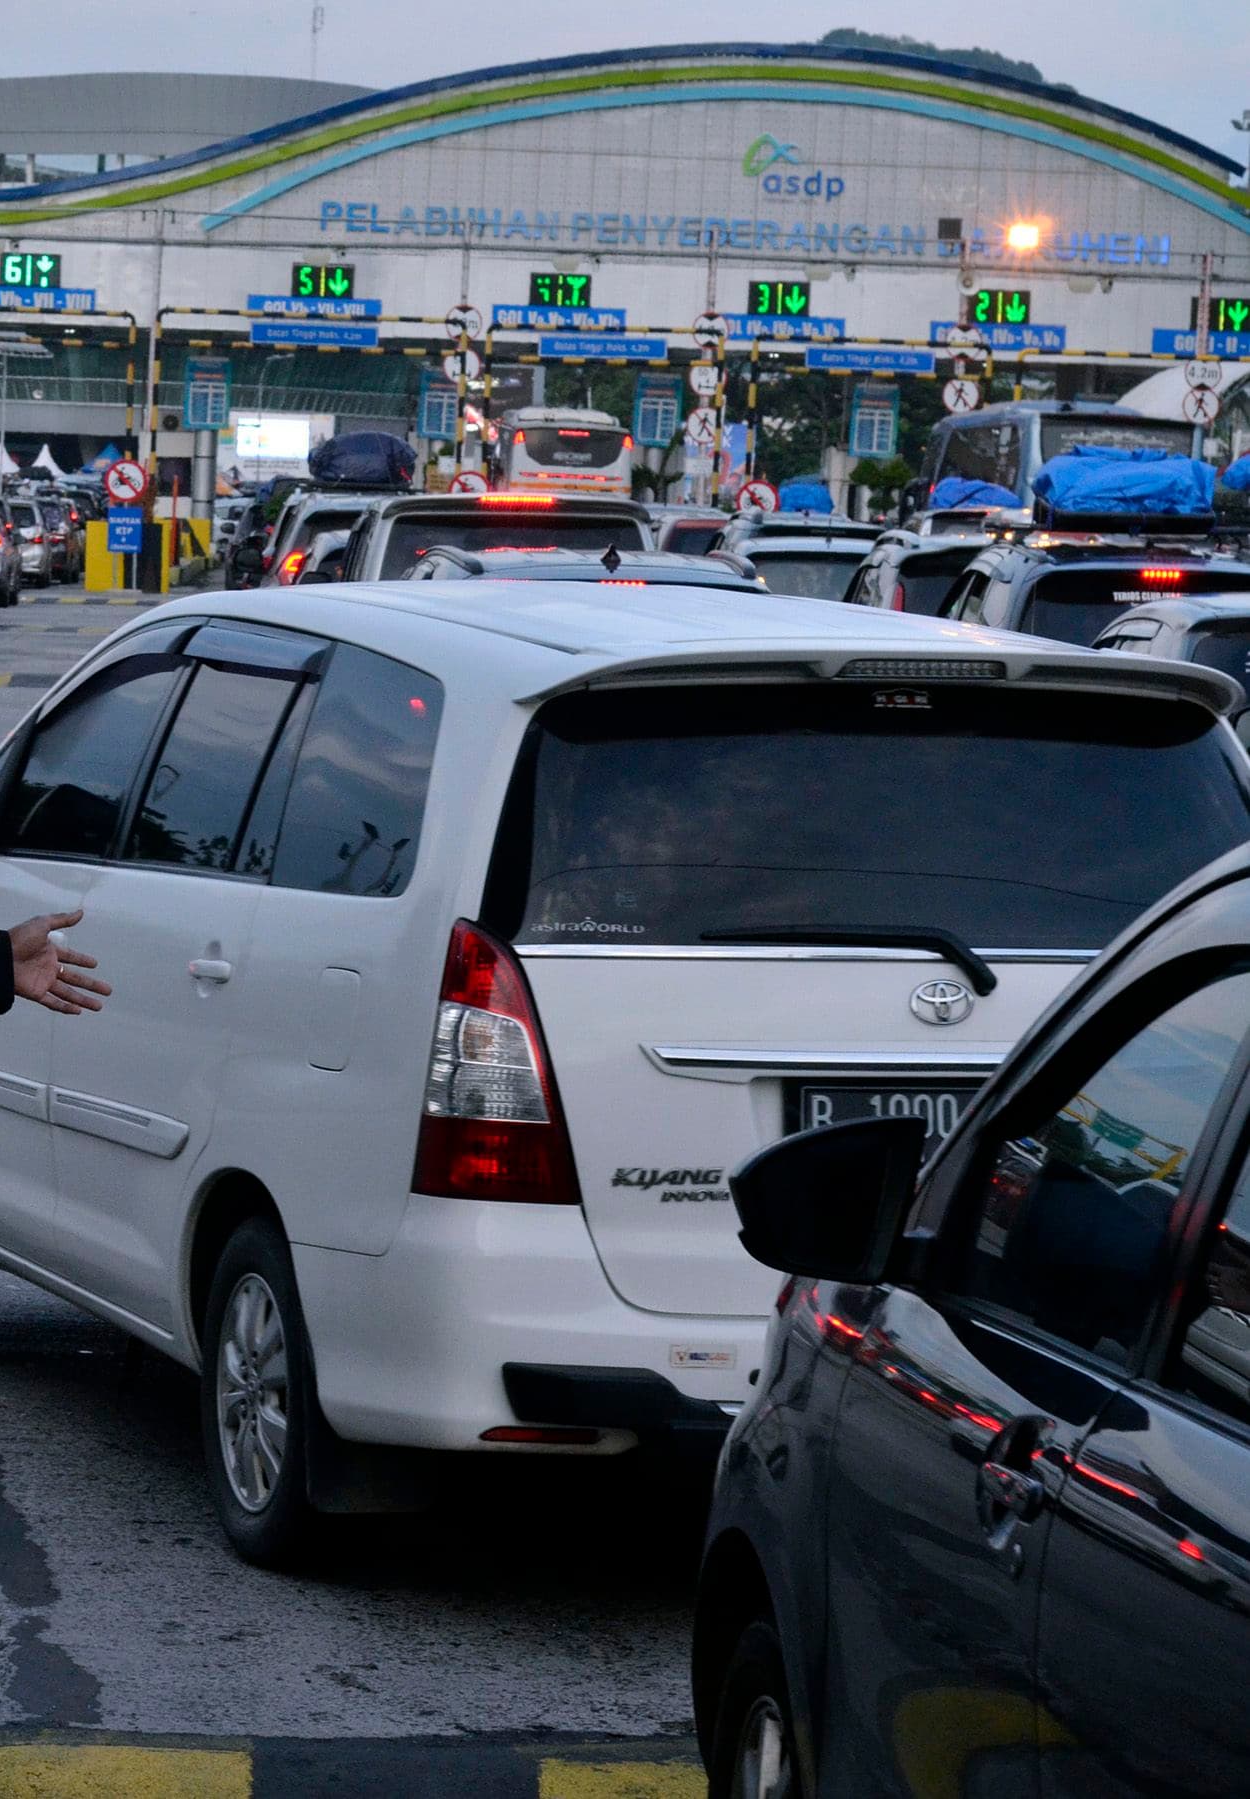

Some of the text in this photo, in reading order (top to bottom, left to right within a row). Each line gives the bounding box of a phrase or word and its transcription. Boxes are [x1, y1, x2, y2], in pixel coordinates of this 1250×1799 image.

[762, 169, 844, 202] asdp
[320, 201, 560, 241] PELABUHAN
[5, 256, 22, 283] 6
[757, 284, 770, 314] 3
[976, 291, 990, 322] 2
[497, 310, 523, 326] GOL
